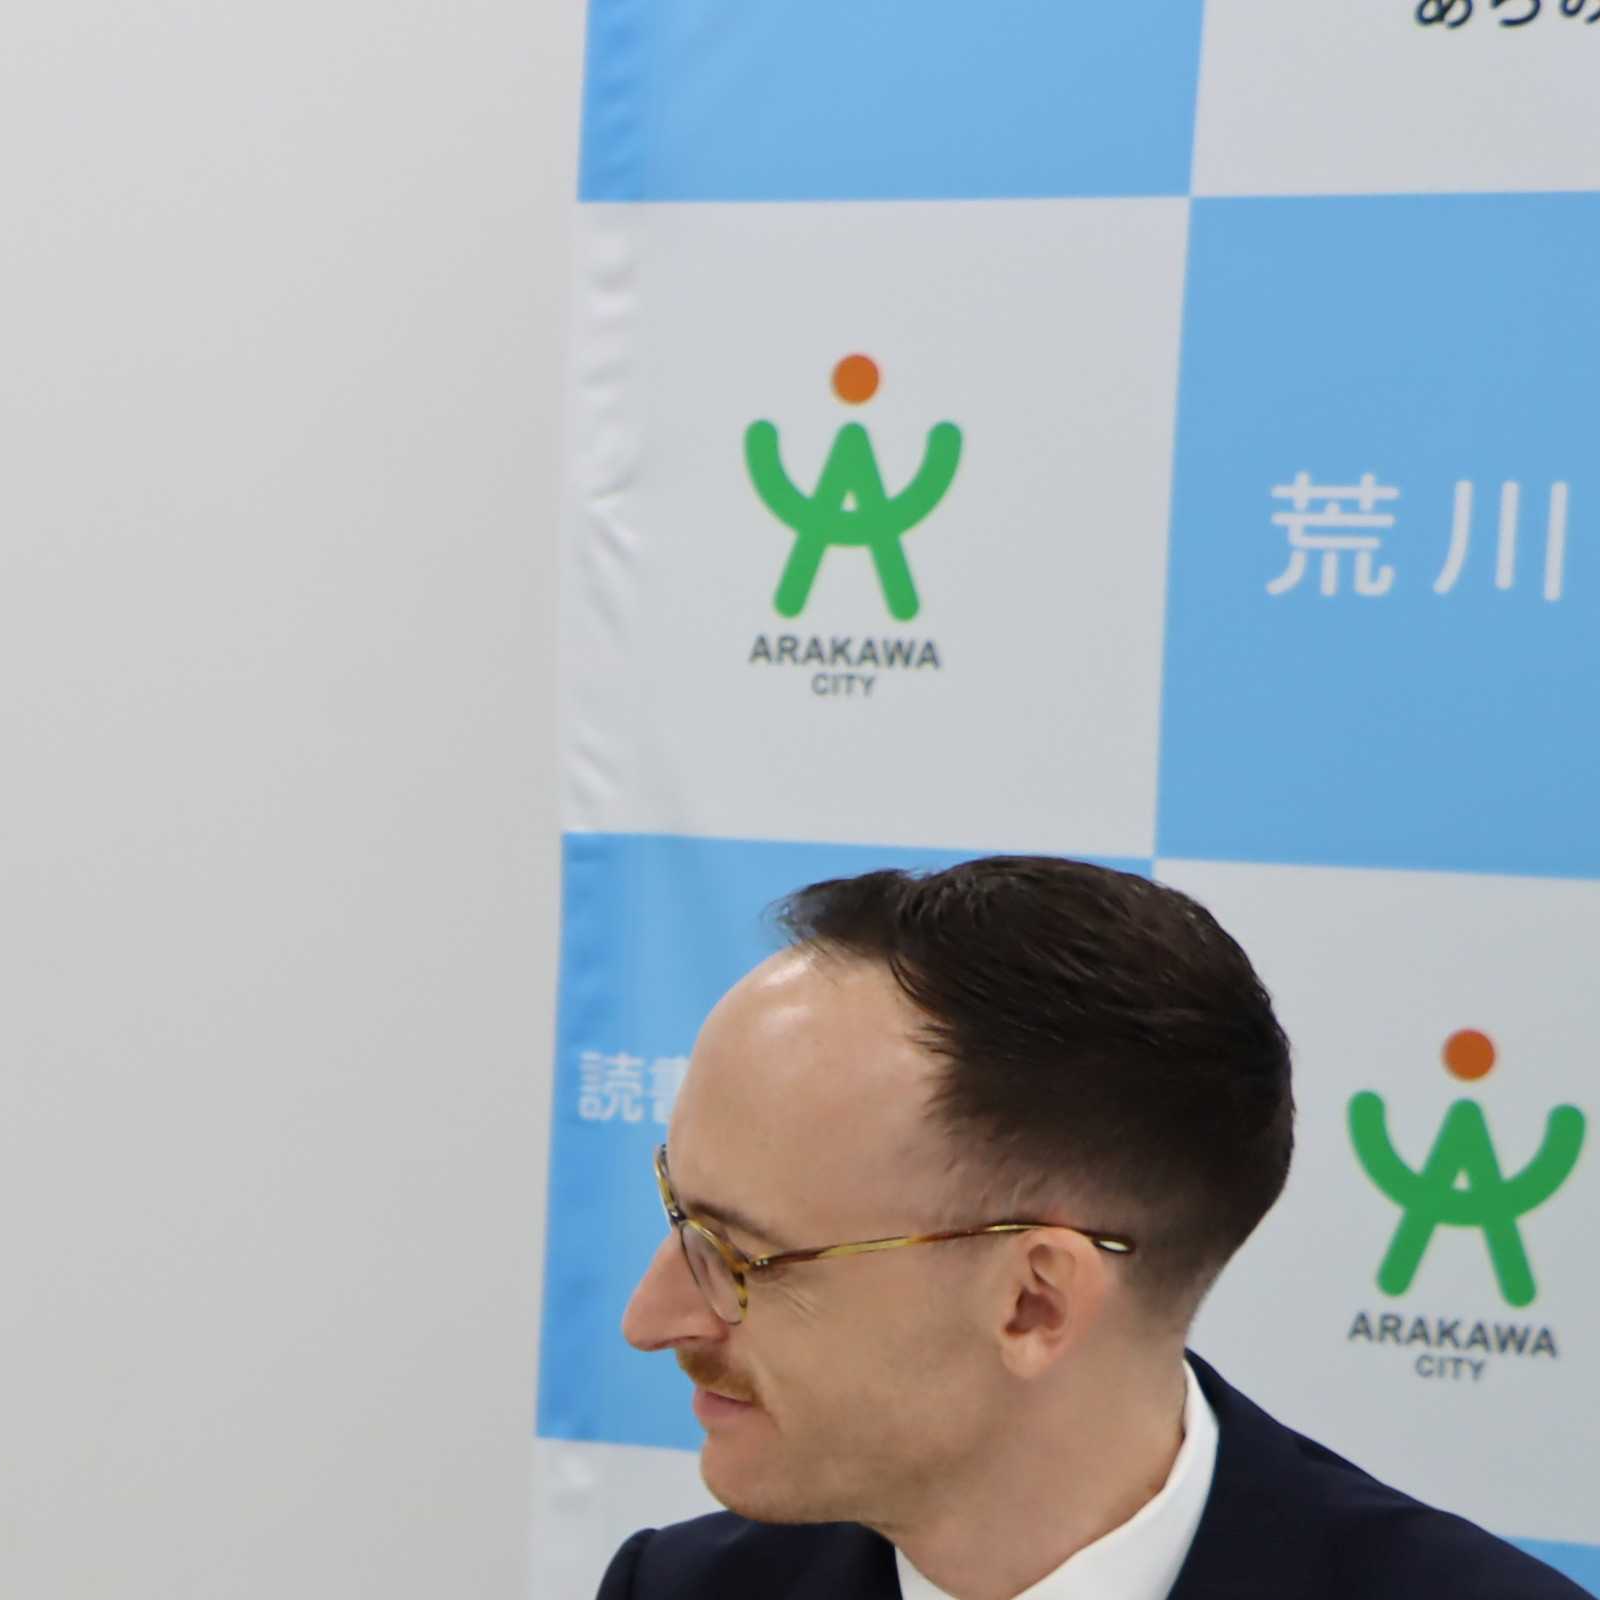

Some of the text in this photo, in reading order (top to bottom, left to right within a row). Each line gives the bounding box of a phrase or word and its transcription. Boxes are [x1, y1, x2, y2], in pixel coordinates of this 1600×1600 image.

[1266, 470, 1567, 601] 荒川
[749, 634, 941, 670] ARAKAWA
[811, 672, 876, 697] CITY
[1347, 1310, 1558, 1359] ARAKAWA
[1414, 1353, 1485, 1381] CITY
